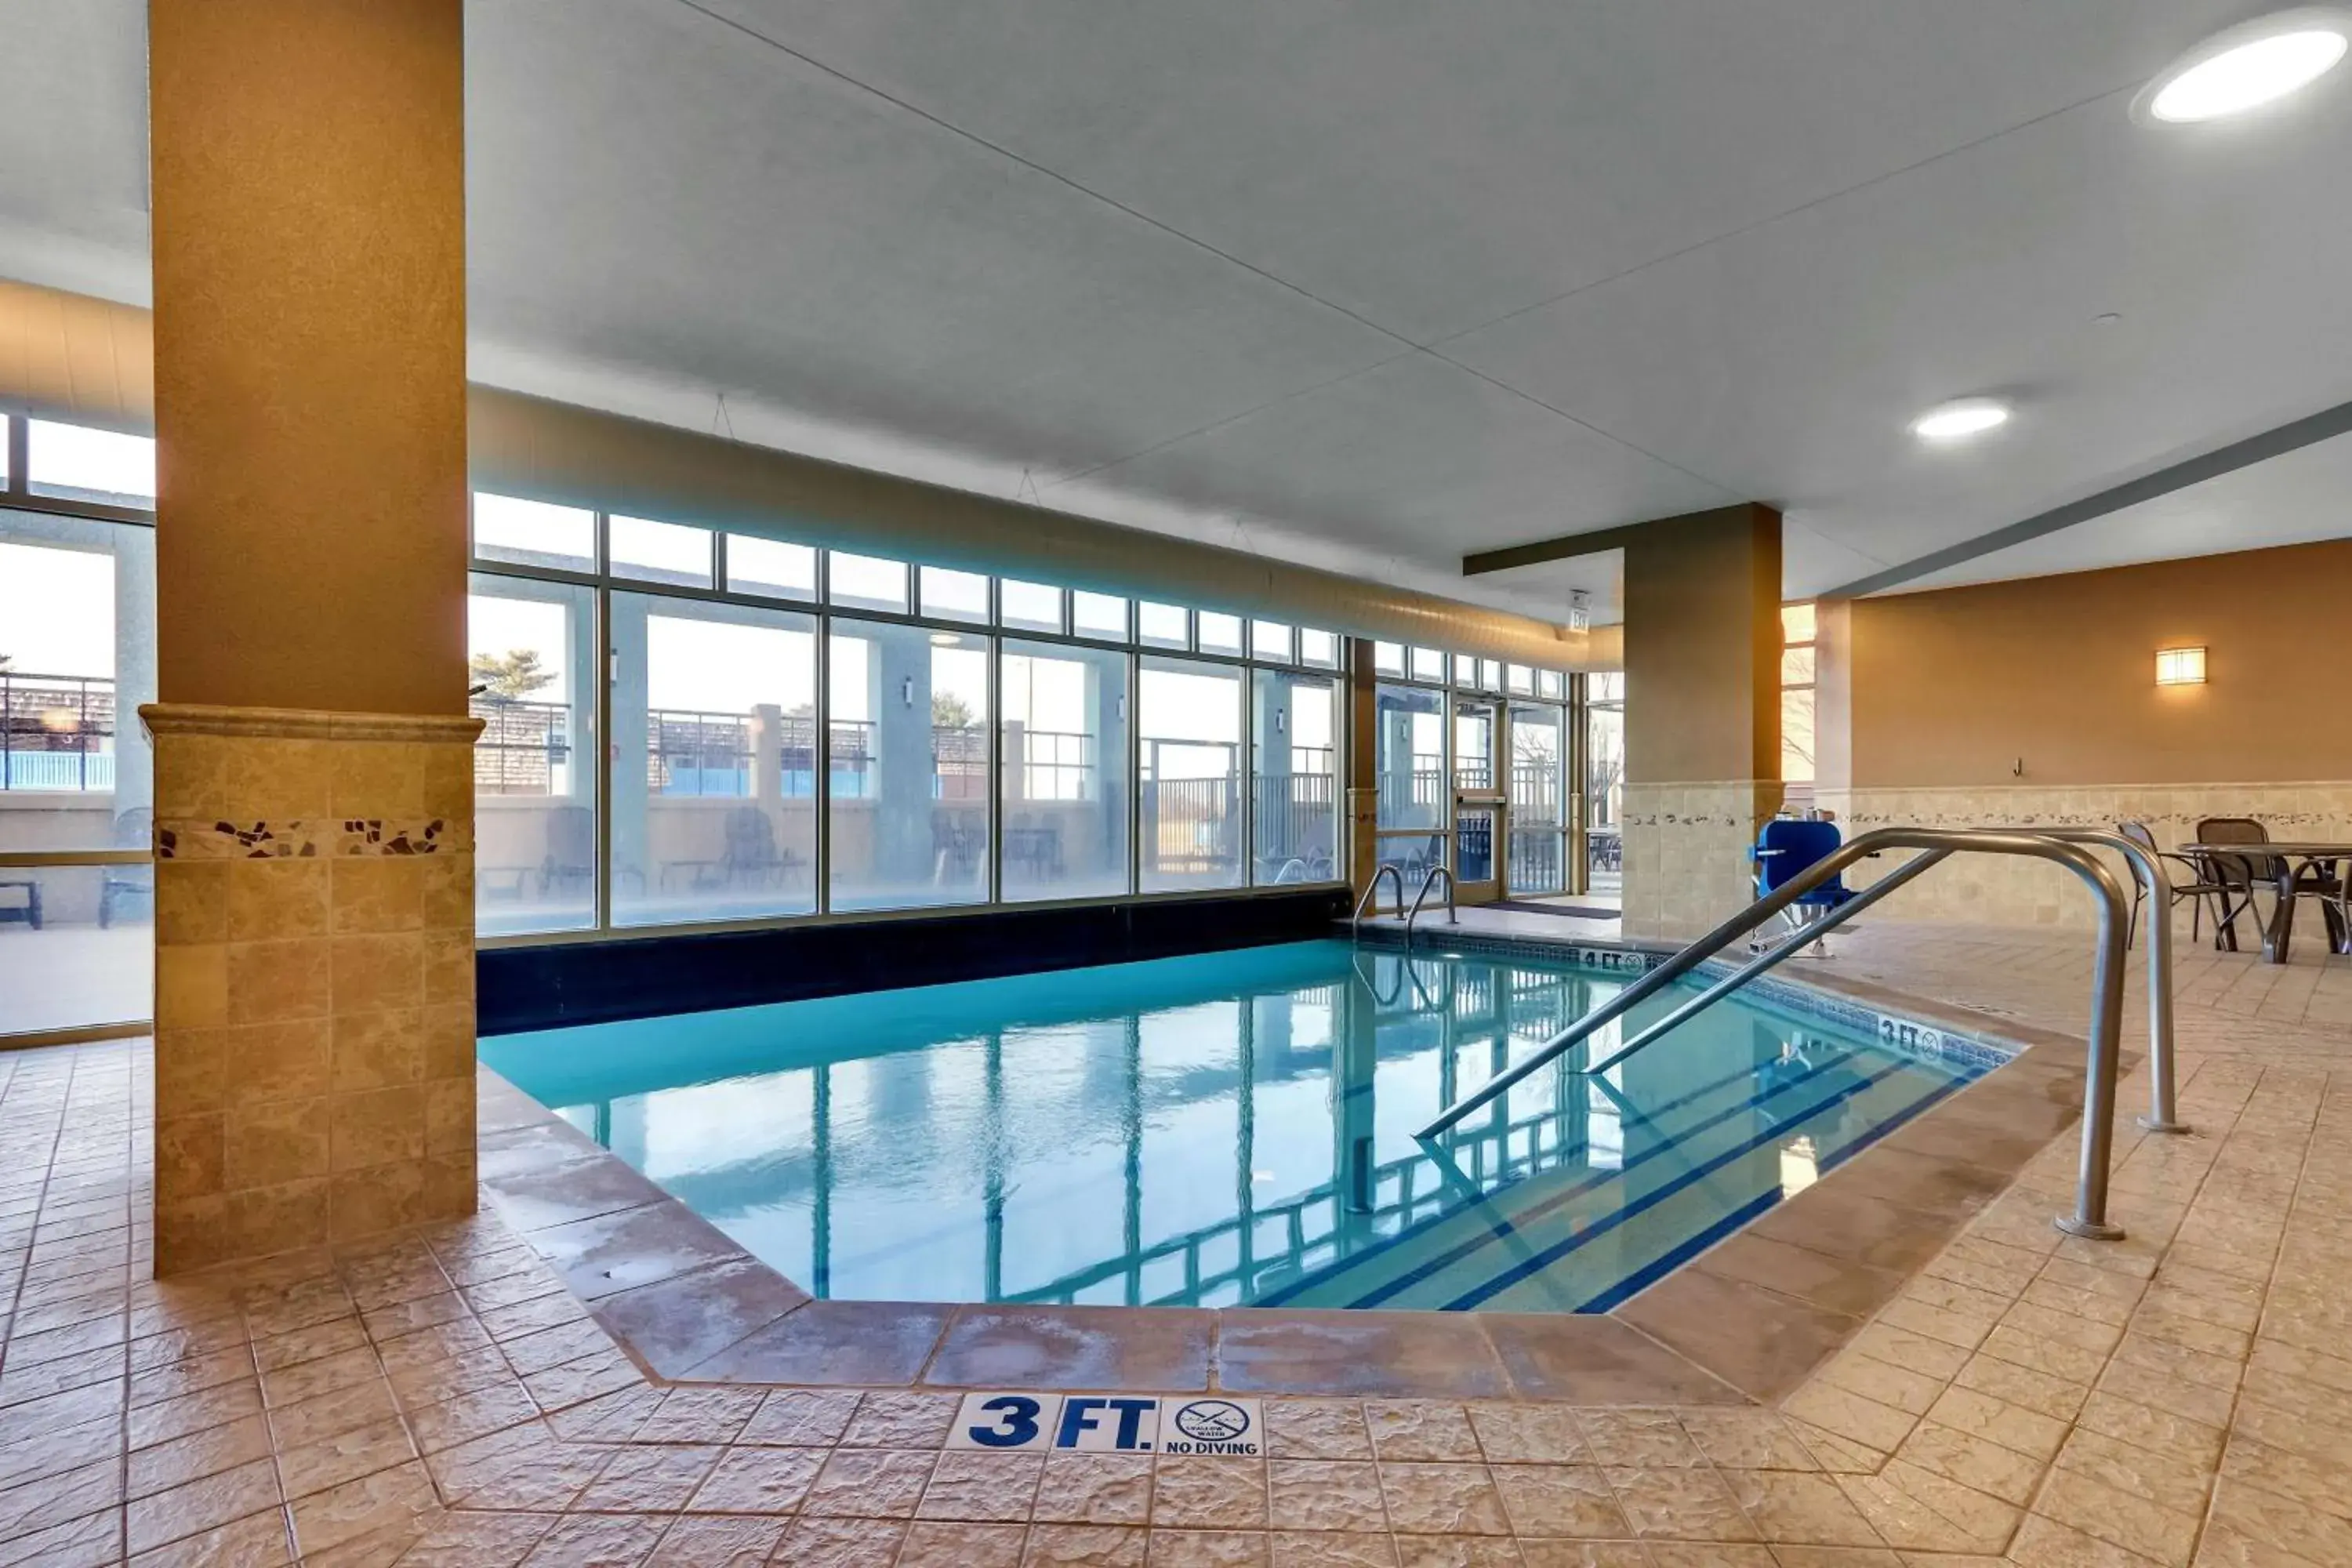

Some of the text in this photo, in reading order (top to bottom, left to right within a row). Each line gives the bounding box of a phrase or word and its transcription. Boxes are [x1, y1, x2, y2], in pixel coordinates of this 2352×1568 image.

[1882, 1020, 1894, 1045] 3
[969, 1396, 1156, 1449] 3 FT.
[1167, 1442, 1258, 1454] NO DIVING
